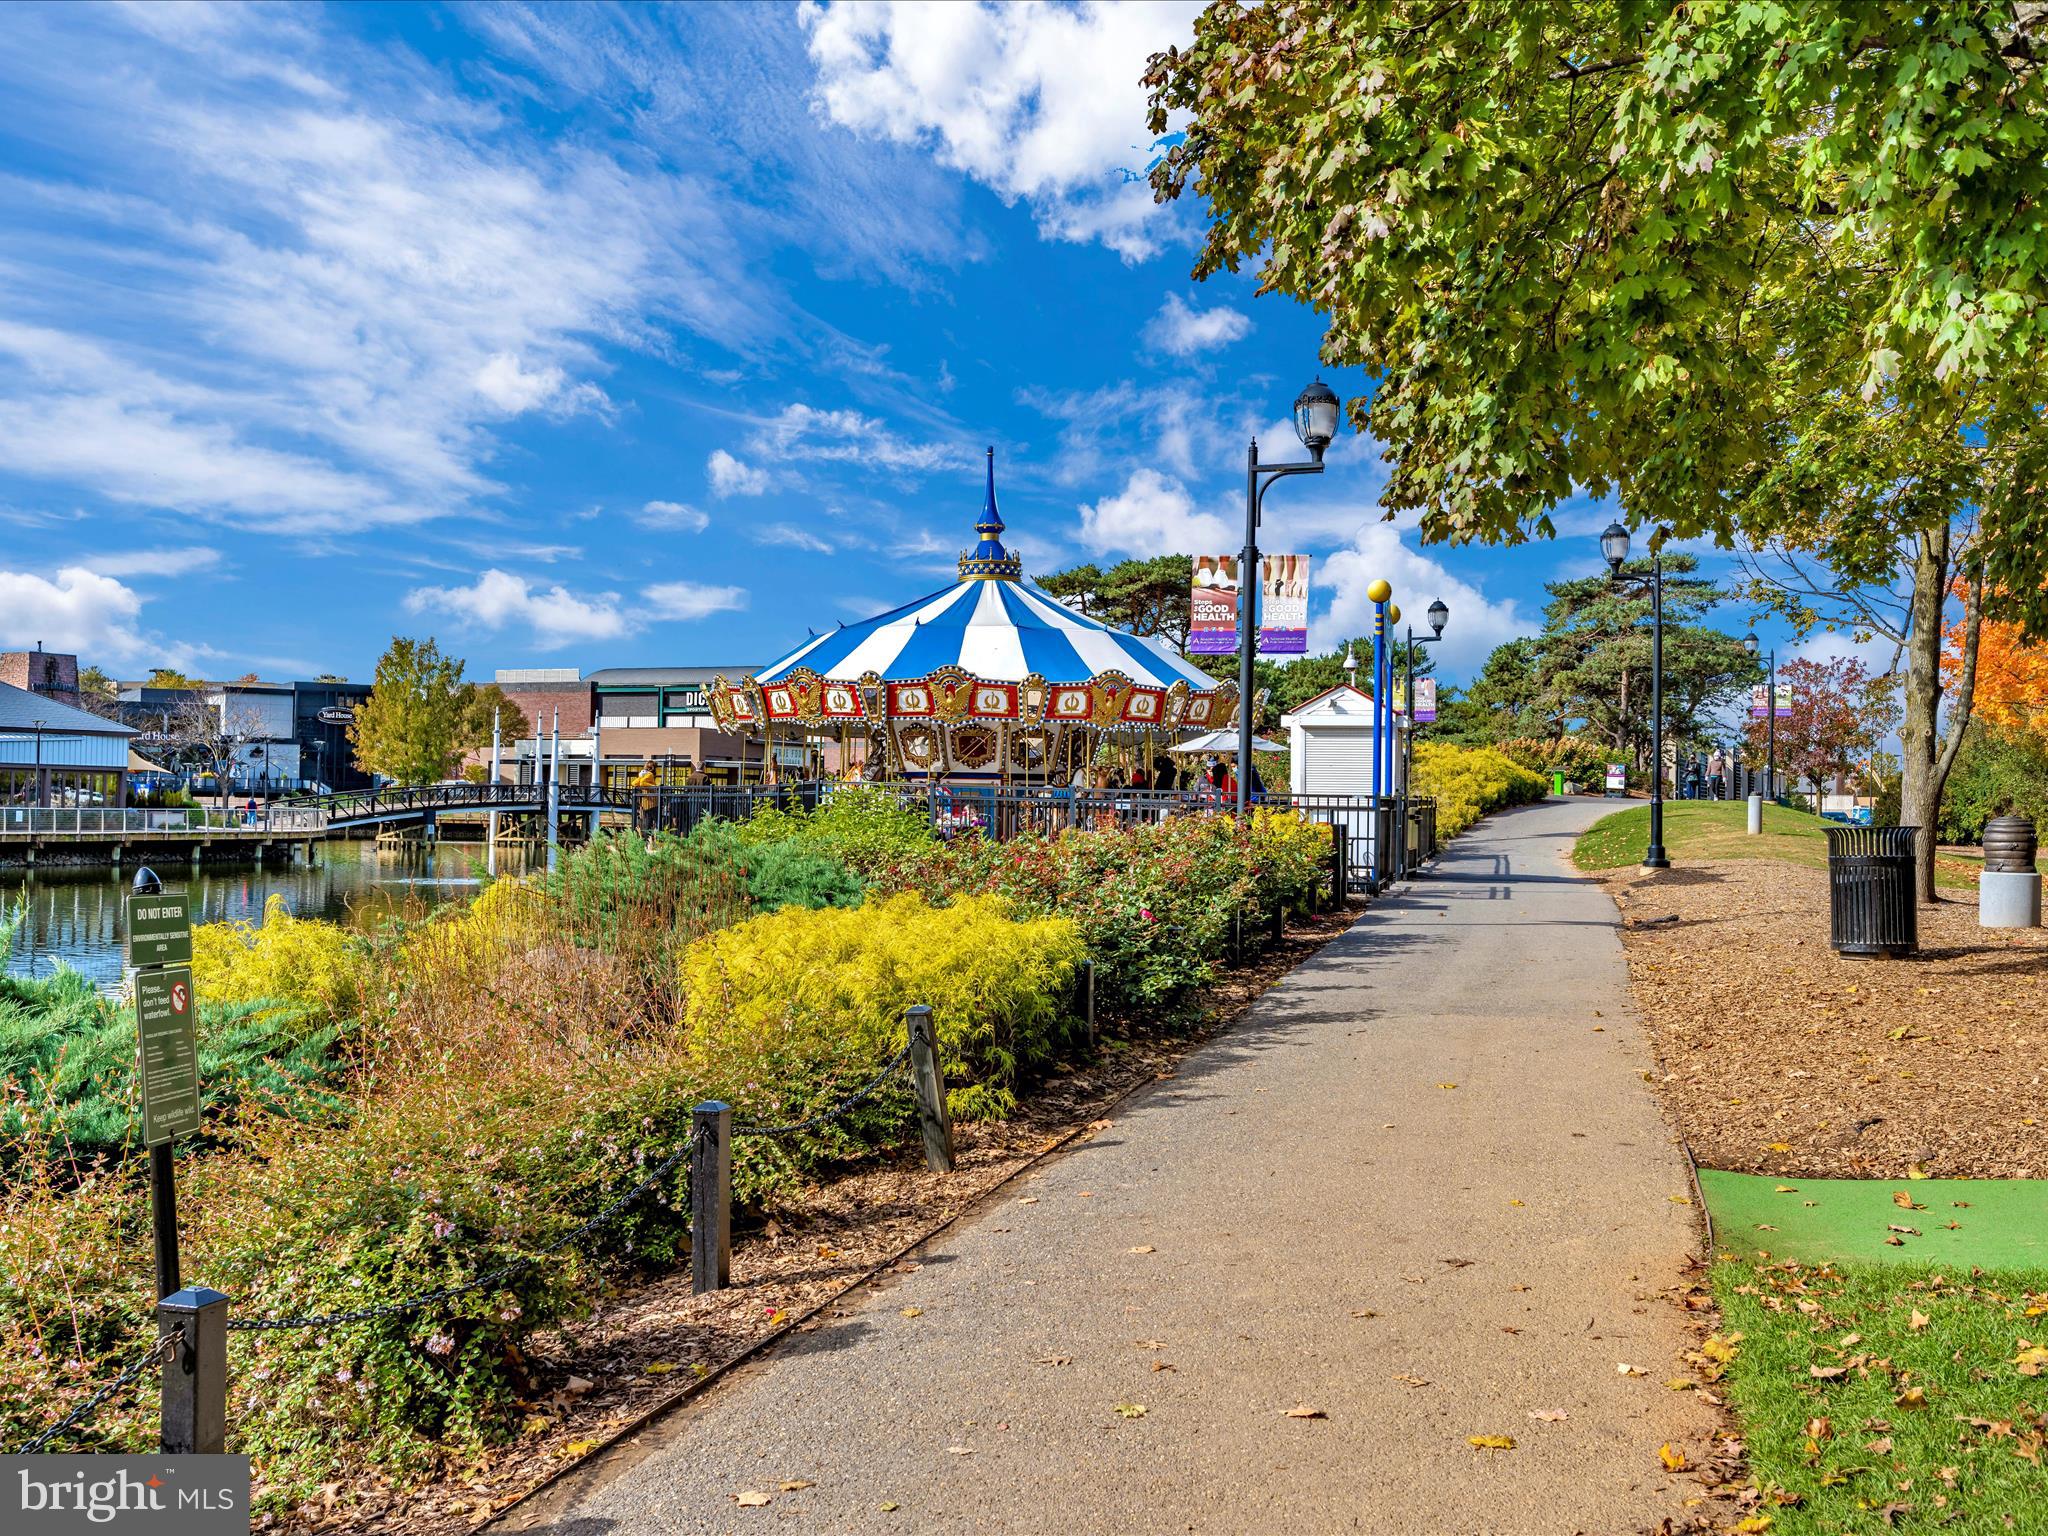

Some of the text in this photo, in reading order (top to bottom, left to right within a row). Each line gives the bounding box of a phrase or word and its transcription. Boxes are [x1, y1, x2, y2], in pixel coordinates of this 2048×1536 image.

[1198, 605, 1229, 613] GOOD
[1268, 605, 1300, 613] GOOD
[1194, 612, 1235, 621] HEALTH
[1263, 612, 1305, 621] HEALTH
[686, 691, 707, 706] DIC
[323, 711, 335, 719] Yard
[137, 906, 182, 920] DO NOT ENTER
[133, 933, 169, 942] ENVIRONMENTALLY
[156, 943, 168, 952] AREA
[142, 994, 170, 1008] don't feed
[153, 1114, 167, 1124] Keep
